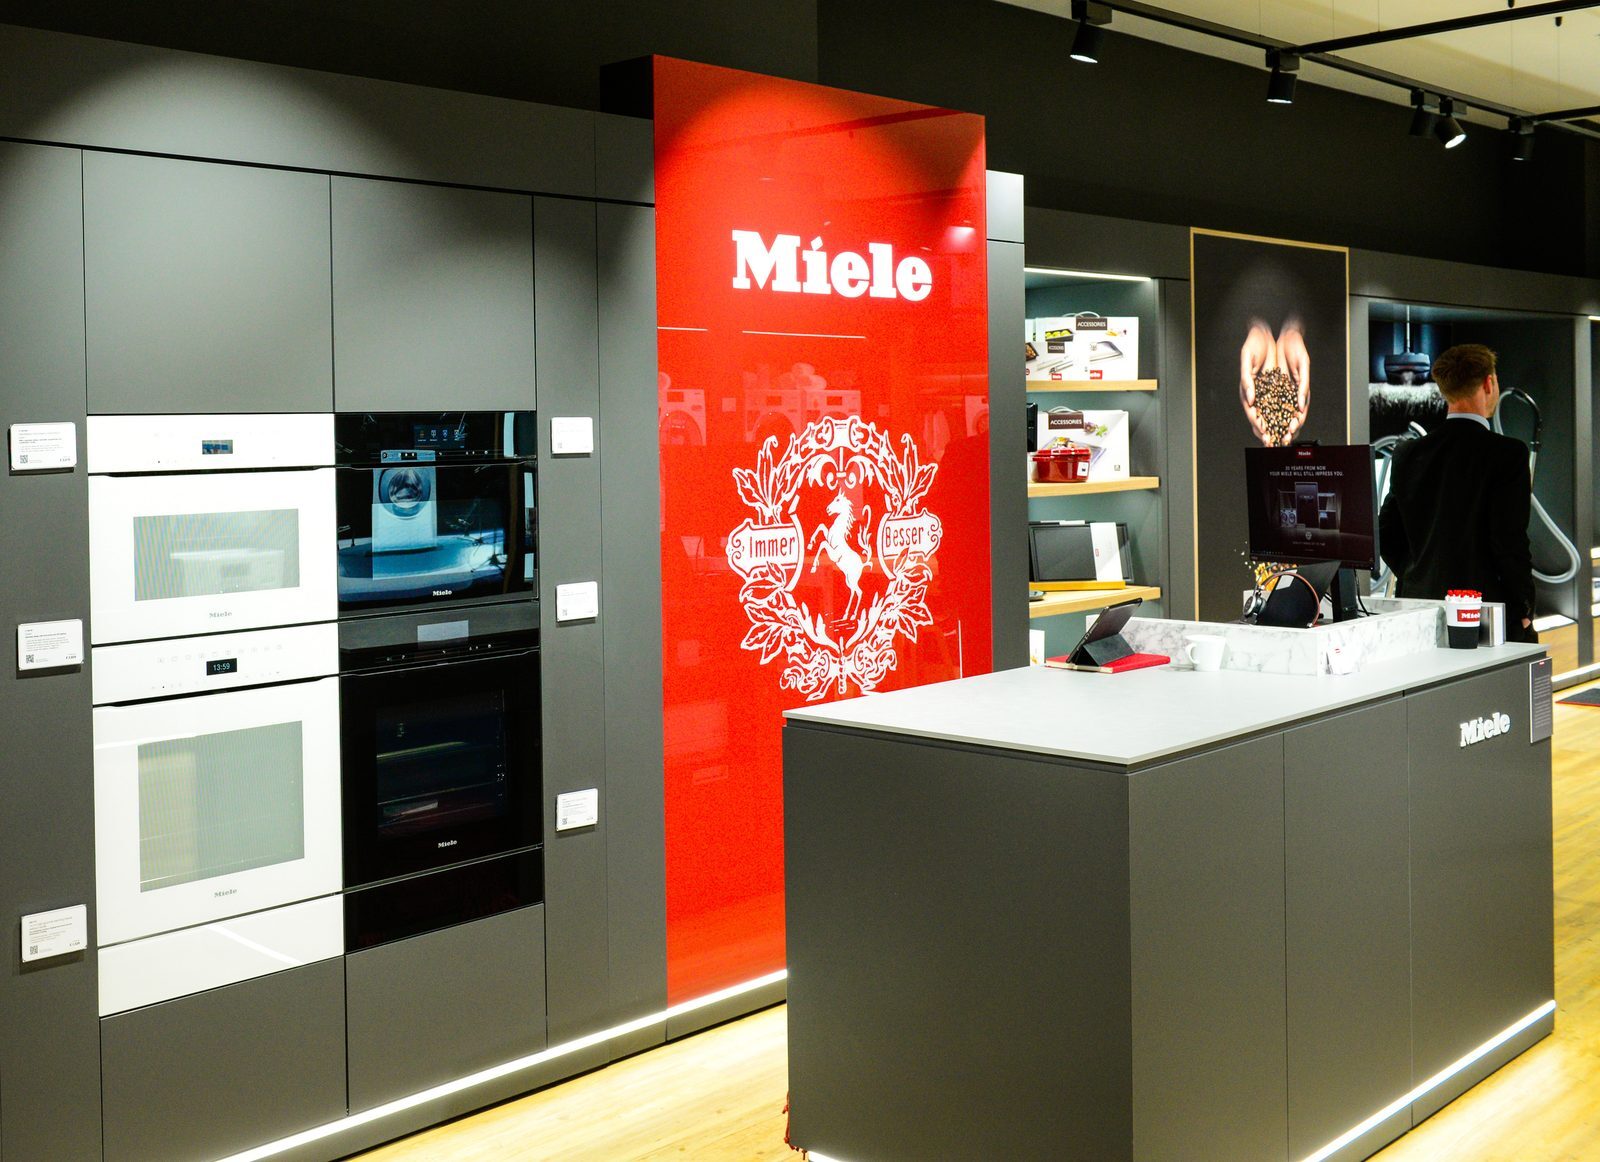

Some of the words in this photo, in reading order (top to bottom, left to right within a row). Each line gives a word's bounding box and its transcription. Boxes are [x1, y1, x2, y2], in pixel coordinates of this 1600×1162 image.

[732, 229, 932, 301] Miele
[885, 525, 925, 548] Besser
[749, 535, 796, 559] Immer
[432, 589, 453, 597] Miele
[208, 611, 233, 619] Miele
[213, 662, 231, 672] 13:59
[1459, 711, 1511, 748] Miele
[437, 839, 458, 848] Miele
[213, 887, 238, 898] Miele
